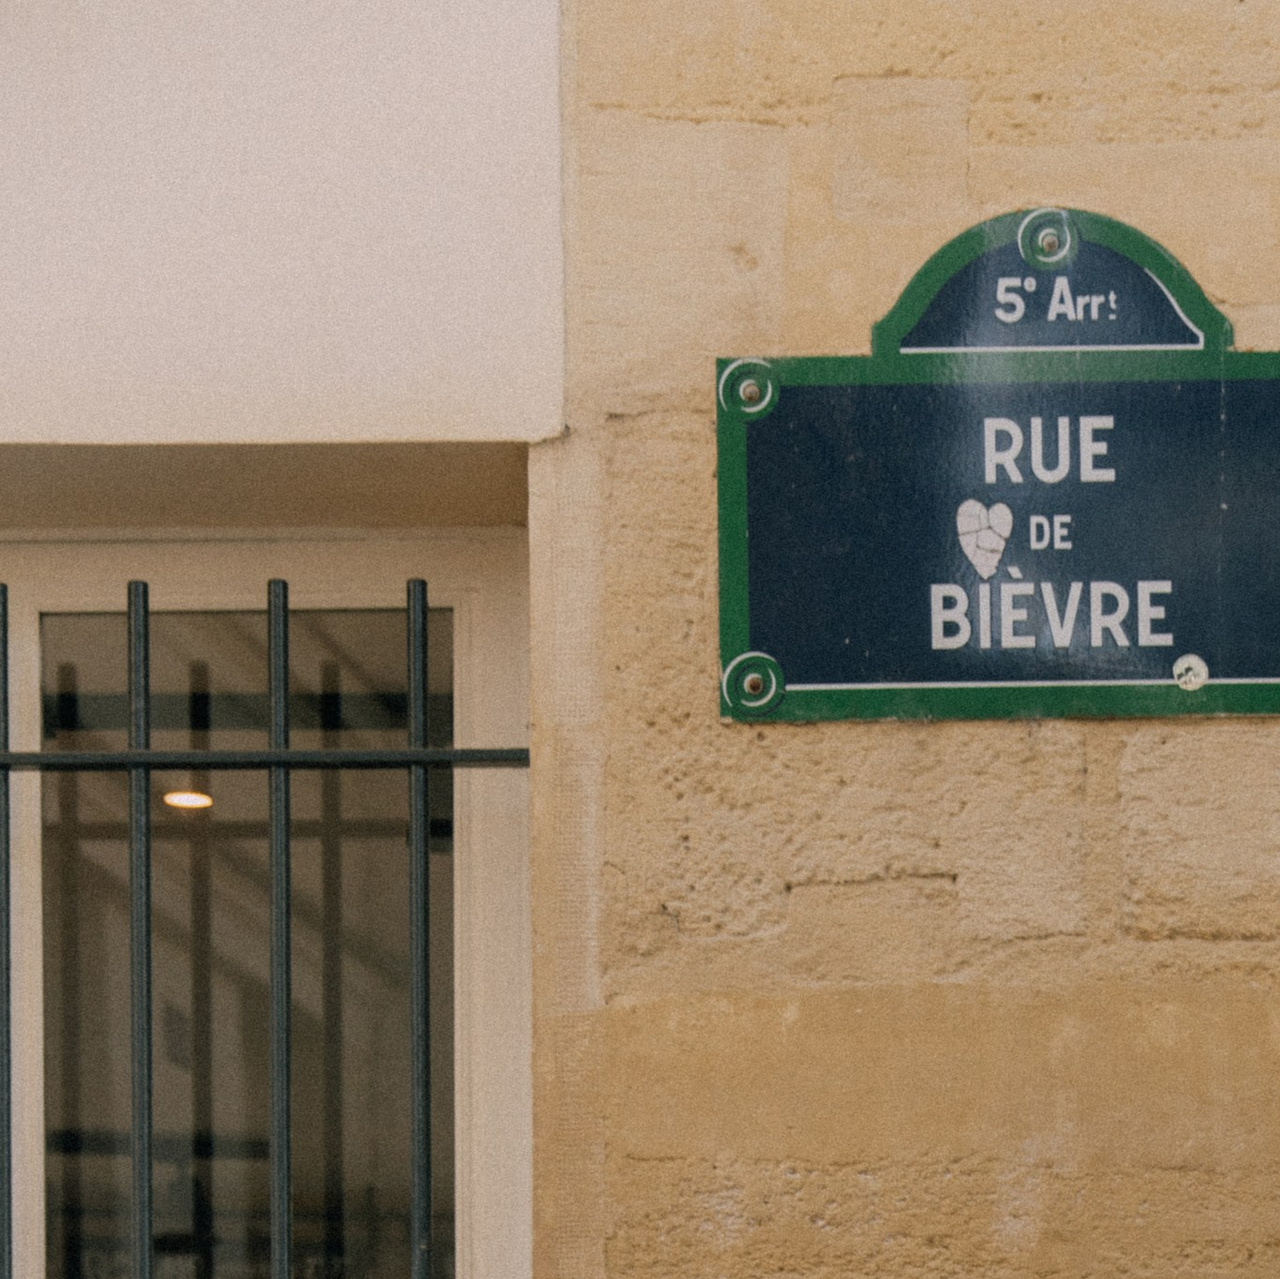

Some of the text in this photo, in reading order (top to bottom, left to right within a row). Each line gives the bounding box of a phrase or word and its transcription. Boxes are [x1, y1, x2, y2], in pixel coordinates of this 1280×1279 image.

[983, 416, 1116, 484] RUE
[1029, 514, 1073, 550] DE
[930, 567, 1174, 649] BIÈVRE
